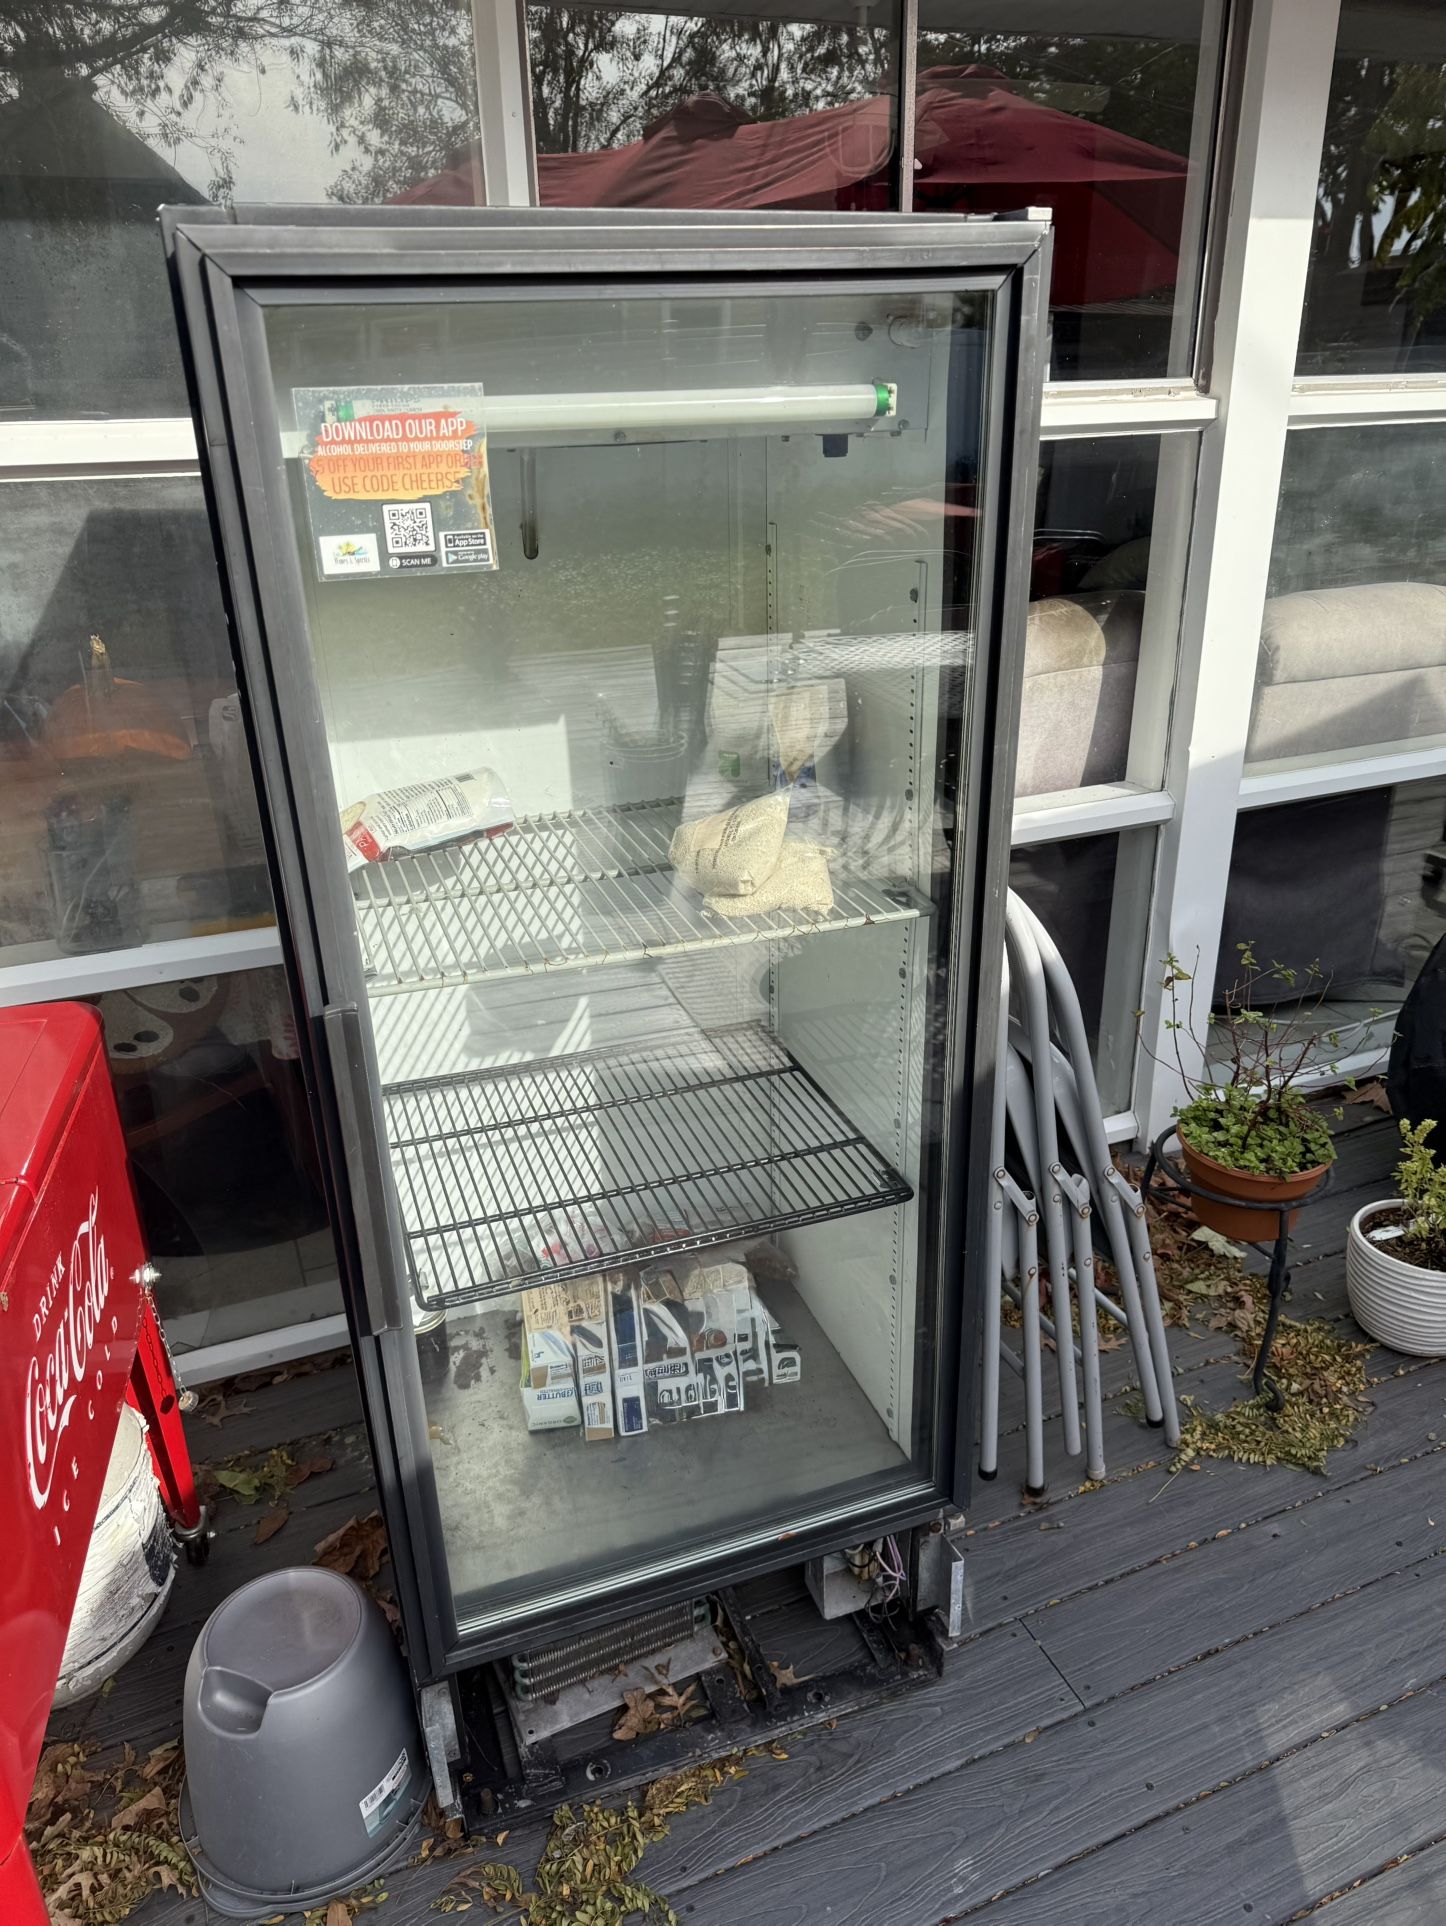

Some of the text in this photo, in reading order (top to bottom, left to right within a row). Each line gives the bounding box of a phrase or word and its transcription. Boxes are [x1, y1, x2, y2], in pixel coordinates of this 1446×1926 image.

[321, 417, 467, 442] DOWNLOAD OUR APP
[317, 439, 473, 456] ALCOHOL DELIVERED TO YOUR DOORSTEP
[327, 457, 348, 474] OFF
[351, 455, 384, 473] YOUR
[386, 454, 418, 471] FIRST
[421, 453, 443, 471] APP
[331, 475, 361, 495] USE
[362, 473, 399, 494] CODE
[455, 537, 484, 547] App Store
[402, 557, 432, 566] SCAN ME
[458, 553, 488, 562] Google play
[32, 1250, 66, 1343] DRINK
[25, 1185, 110, 1510] Coca-Cola
[54, 1315, 118, 1546] ICE COLD
